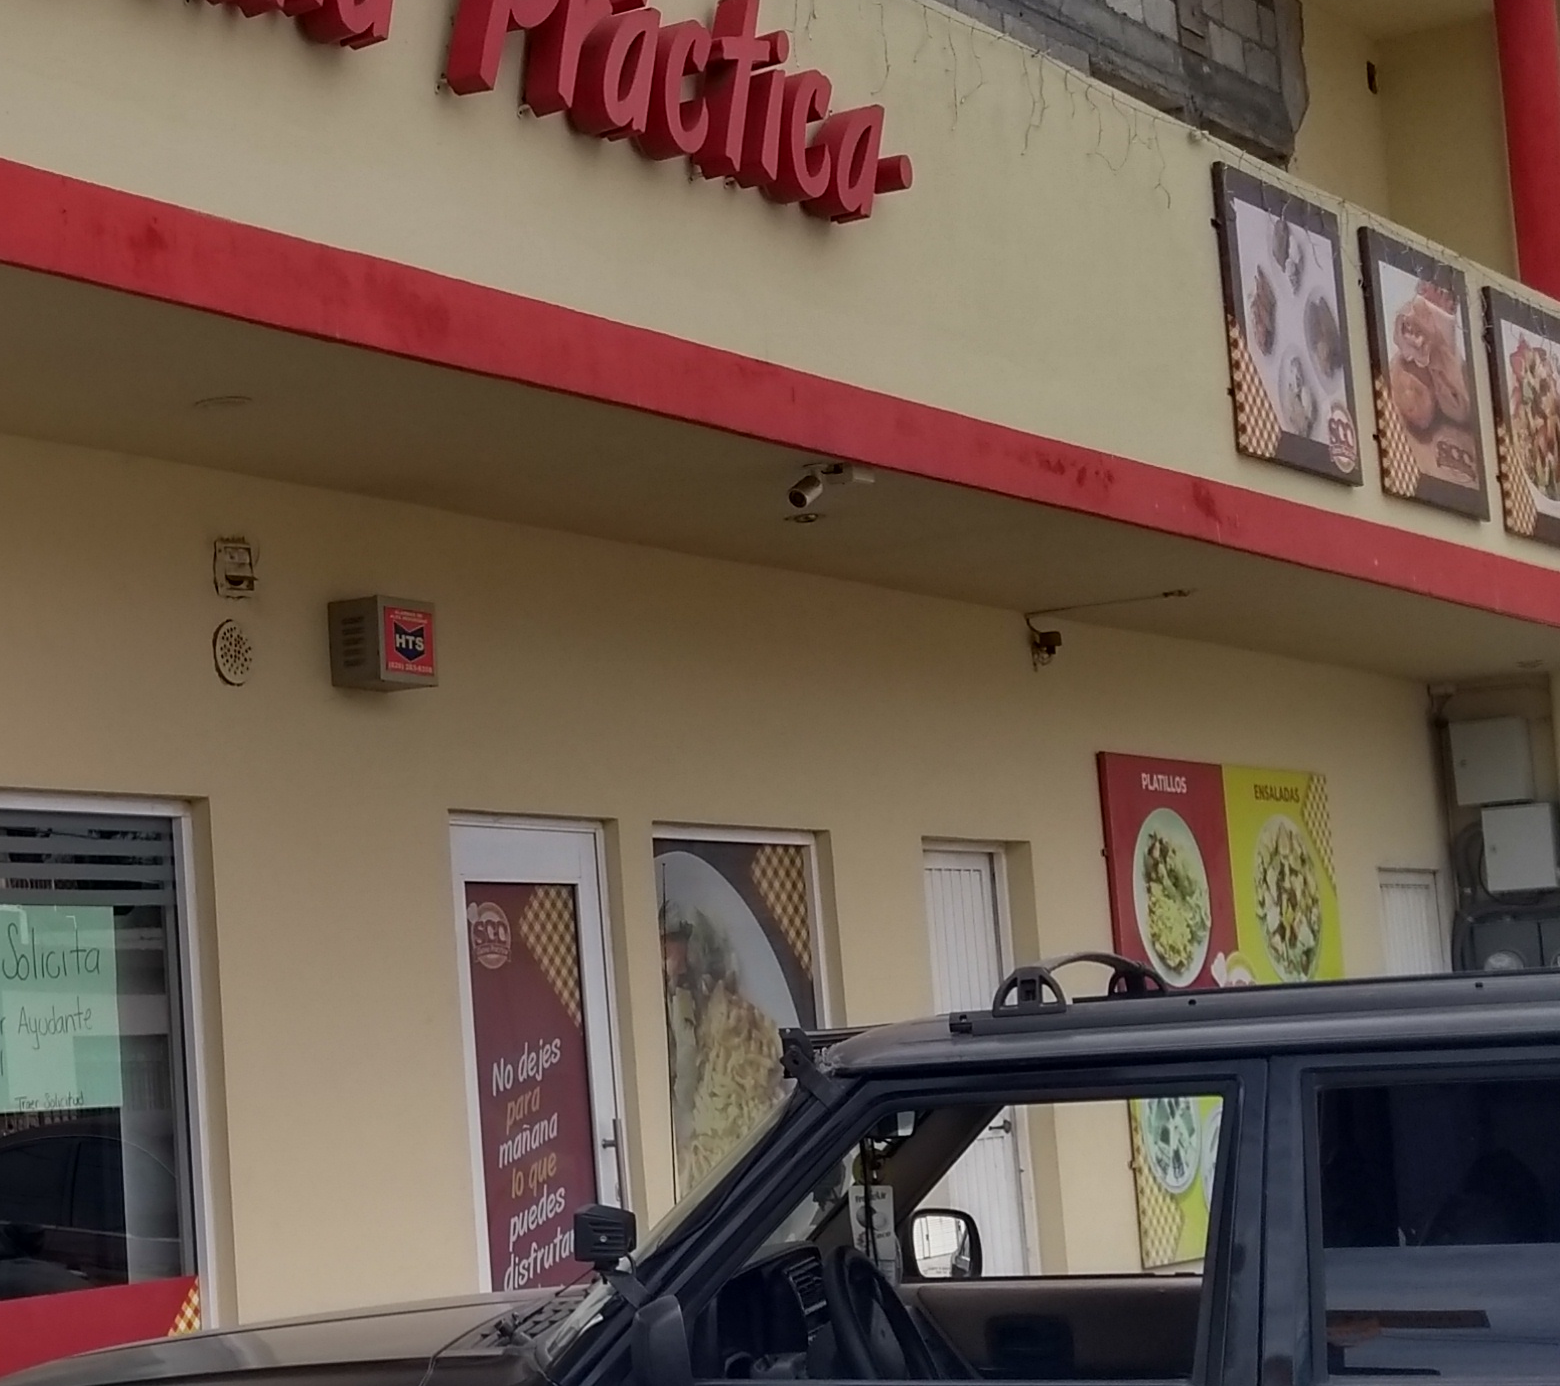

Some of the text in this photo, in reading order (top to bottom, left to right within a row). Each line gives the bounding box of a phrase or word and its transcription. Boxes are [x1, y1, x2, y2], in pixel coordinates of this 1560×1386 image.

[395, 633, 424, 651] HTS
[1141, 772, 1188, 794] PLATILLOS
[1253, 784, 1300, 804] ENSALADAS
[2, 922, 101, 982] Solicita
[17, 996, 93, 1050] Ayudante
[492, 1038, 561, 1098] No dejes
[506, 1086, 540, 1136] para
[499, 1112, 559, 1169] mañana
[511, 1152, 557, 1199] lo que
[509, 1183, 566, 1253] puedes
